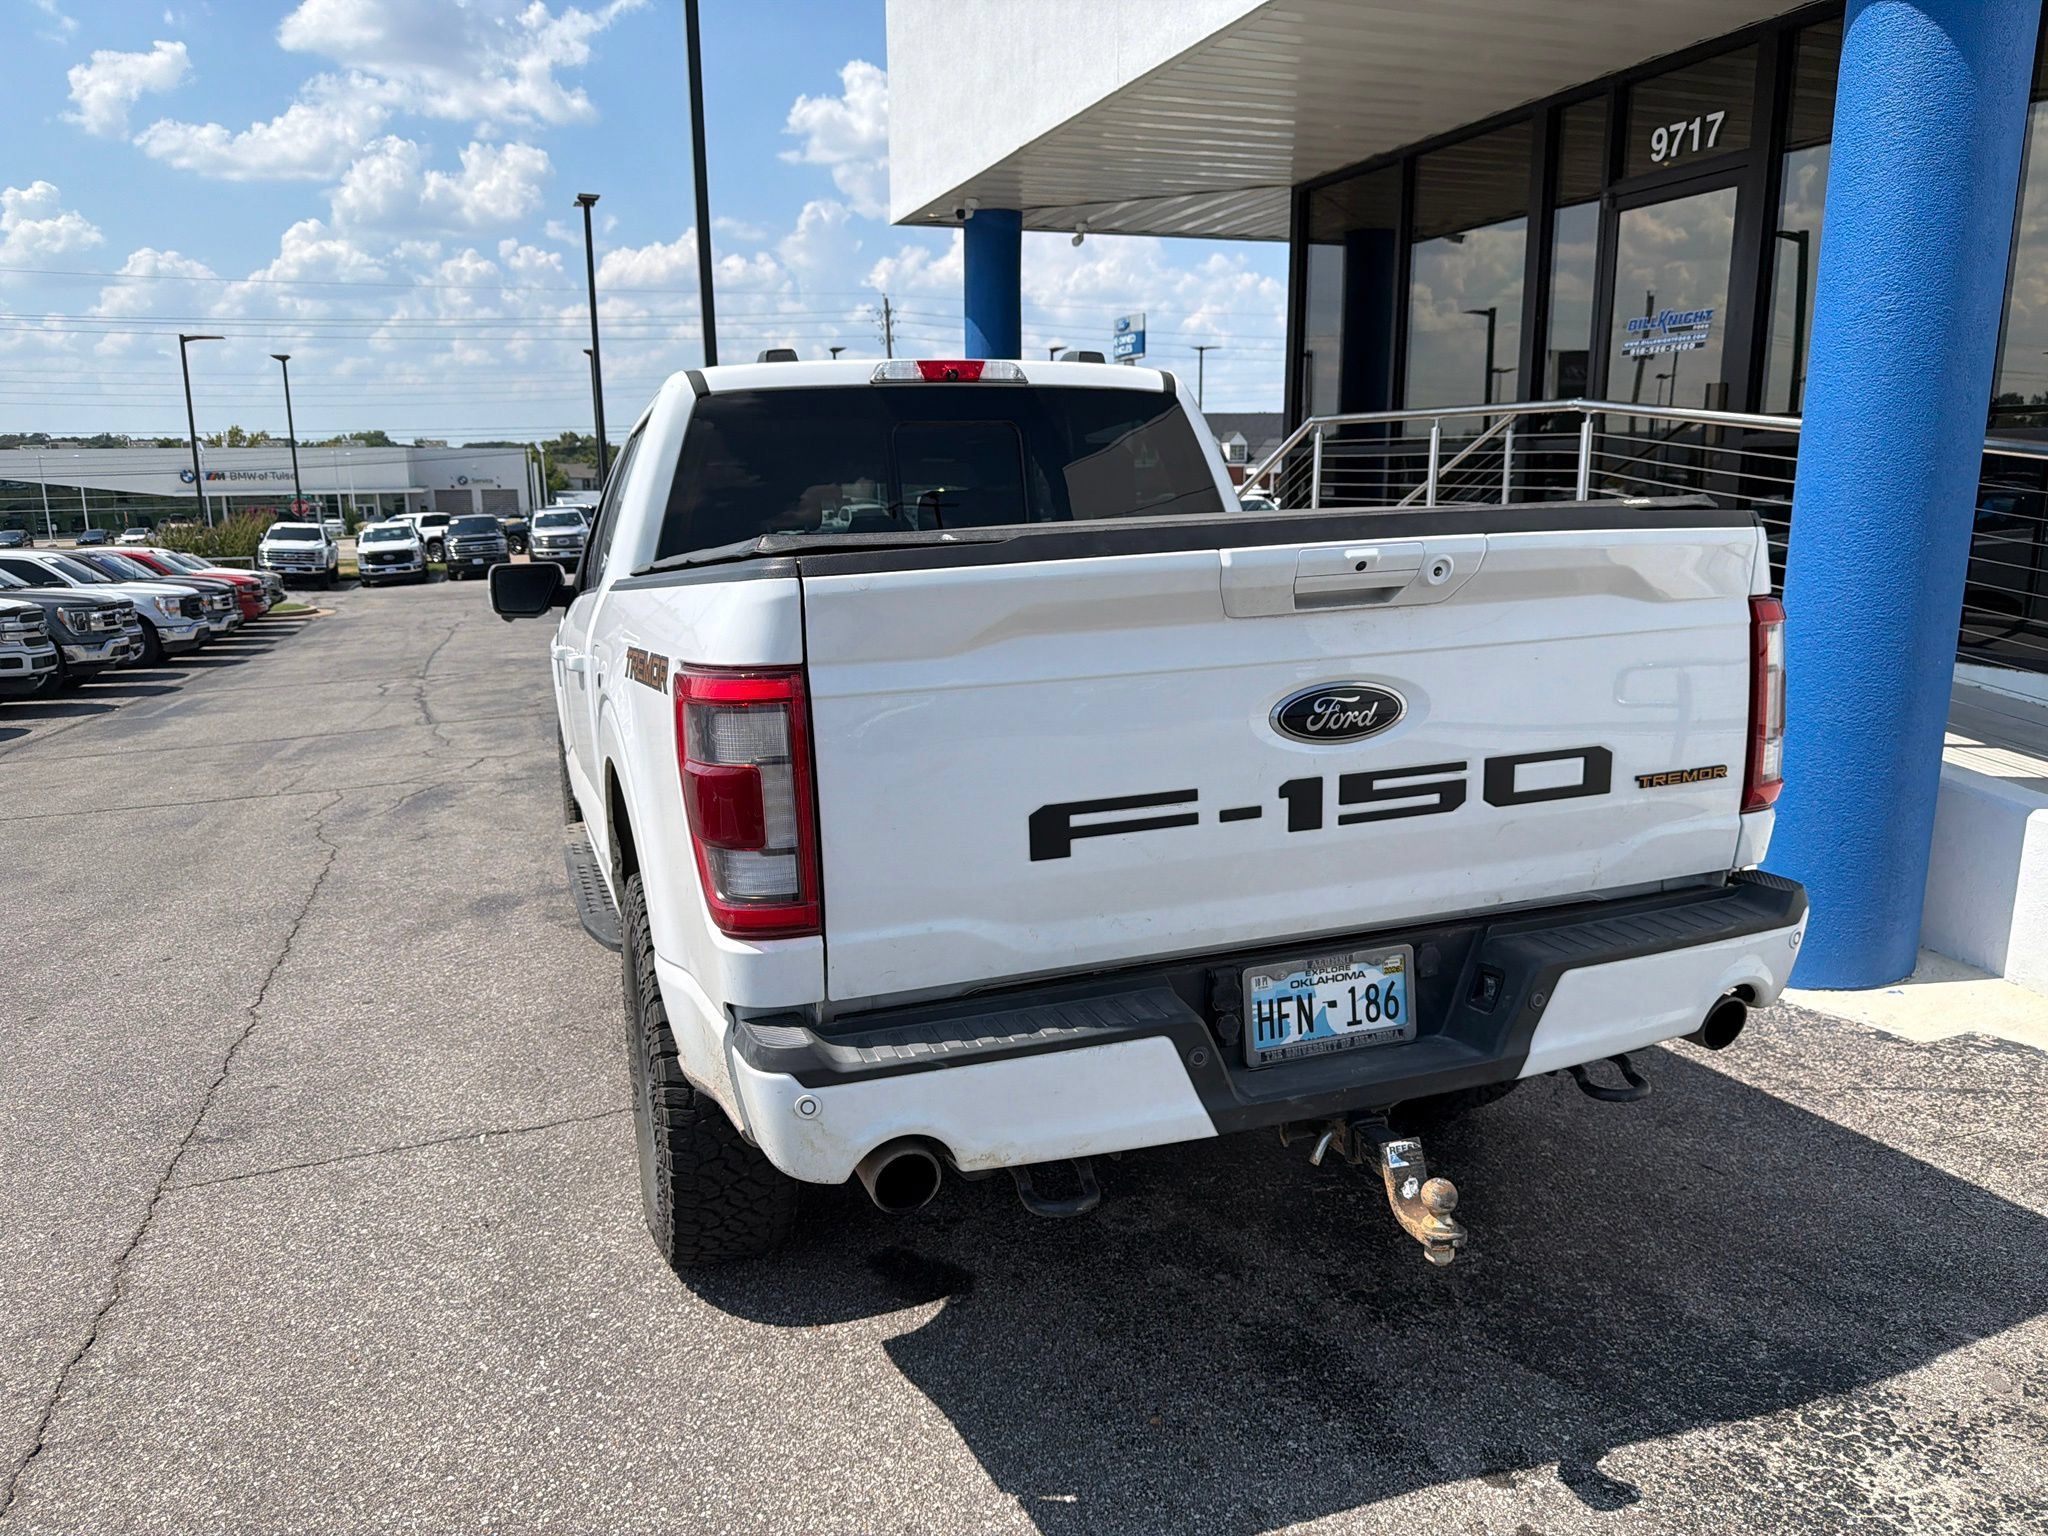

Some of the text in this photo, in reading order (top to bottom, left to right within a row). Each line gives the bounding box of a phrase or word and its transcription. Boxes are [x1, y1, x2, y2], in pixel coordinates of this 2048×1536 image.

[1651, 111, 1725, 162] 9717
[230, 472, 257, 480] BMW
[258, 472, 267, 480] of
[625, 646, 669, 695] TREMOR
[1306, 695, 1379, 732] Ford
[1635, 764, 1728, 788] TREMOR
[1029, 745, 1613, 862] F-150
[1290, 970, 1366, 989] OKLAHOMA
[1305, 964, 1351, 977] EXPLORE
[1265, 1050, 1283, 1061] THE
[1285, 1040, 1338, 1058] UNIVERSITY
[1354, 1030, 1401, 1047] OKLAHOMA
